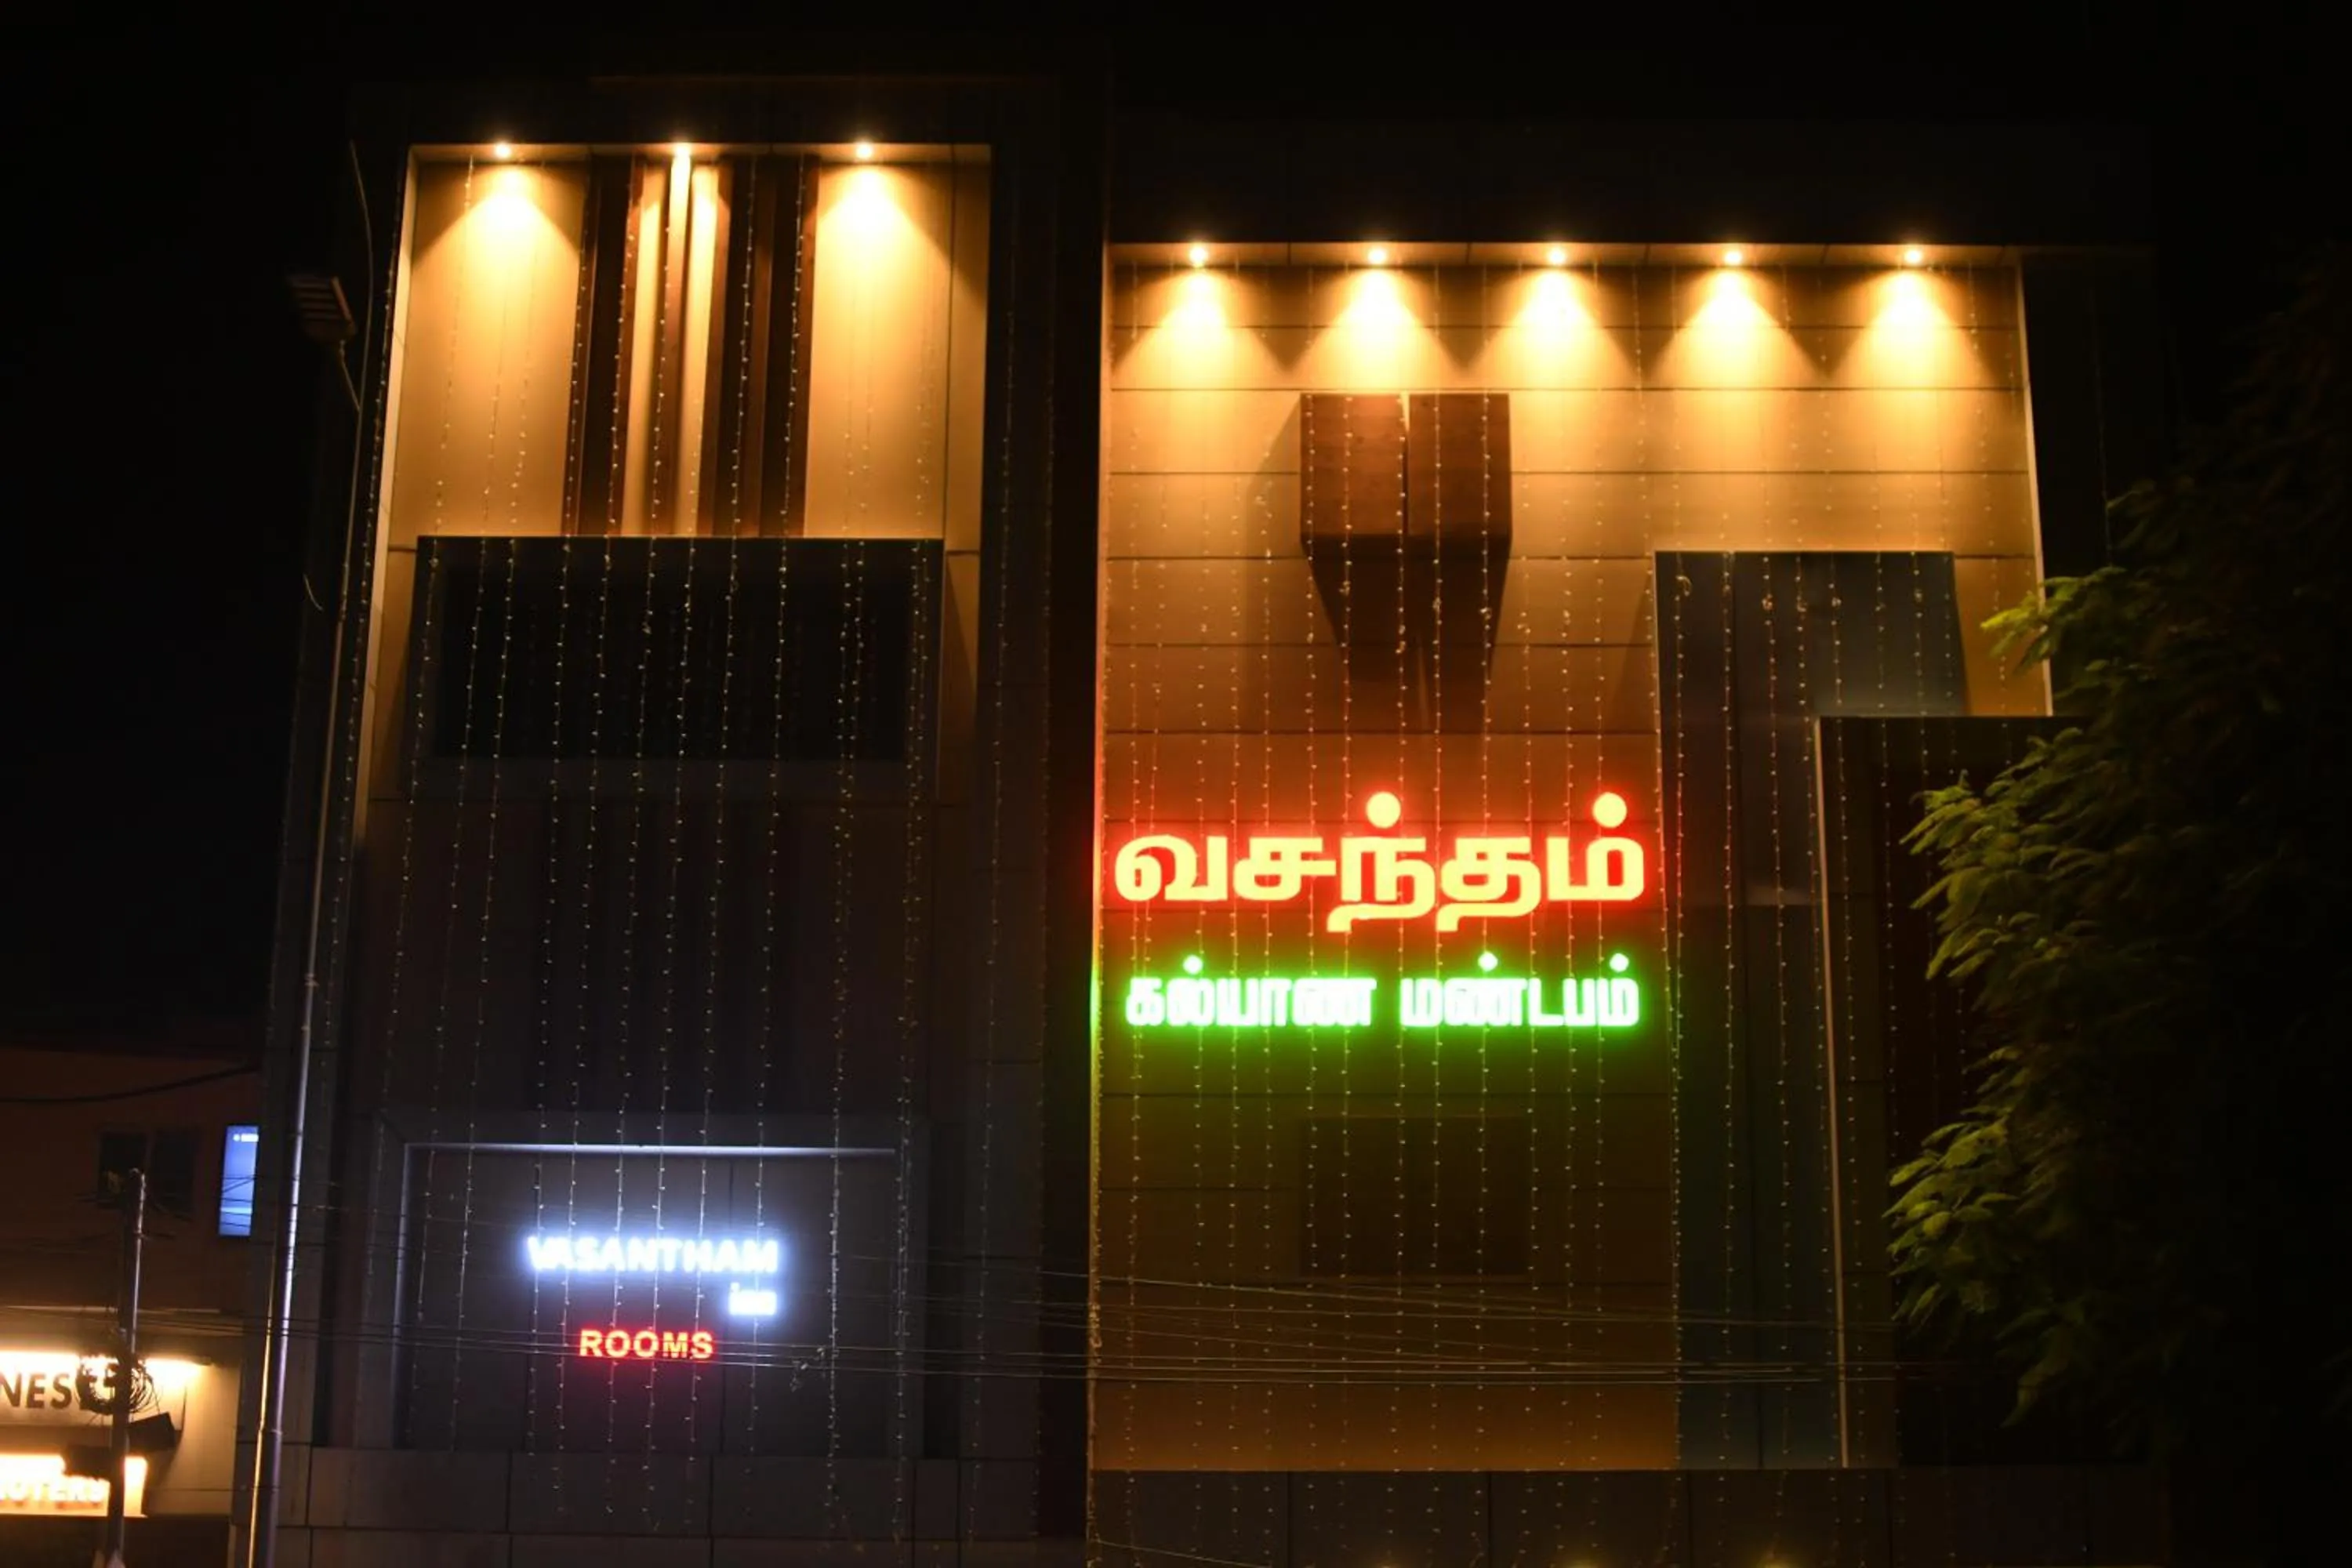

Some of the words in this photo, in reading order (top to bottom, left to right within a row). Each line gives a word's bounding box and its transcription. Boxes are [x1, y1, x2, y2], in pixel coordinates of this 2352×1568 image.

[1114, 791, 1645, 932] வசந்தம்
[1400, 951, 1640, 1026] மண்டபம்
[527, 1236, 779, 1273] VASANTHAM
[579, 1329, 713, 1359] ROOMS
